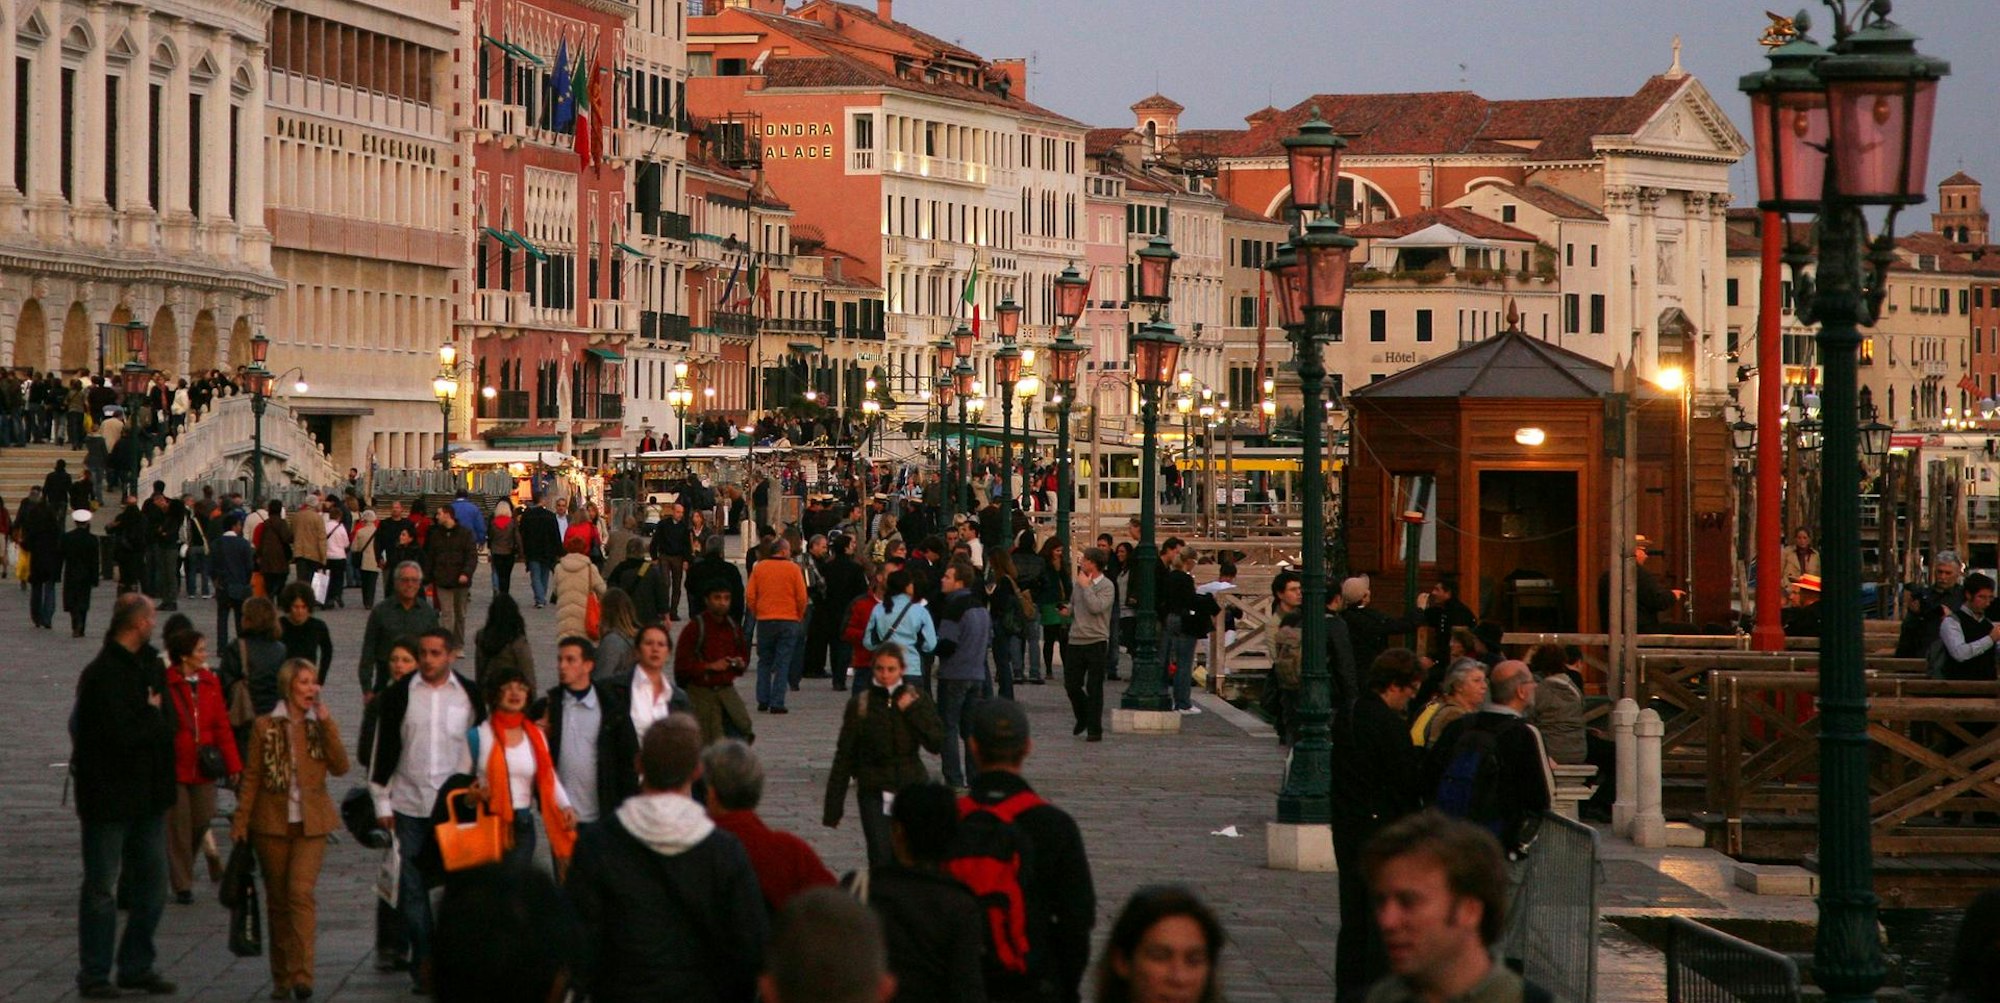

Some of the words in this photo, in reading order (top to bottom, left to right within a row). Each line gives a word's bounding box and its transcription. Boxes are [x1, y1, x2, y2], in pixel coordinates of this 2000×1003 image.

[277, 116, 343, 147] DANIELI
[362, 133, 436, 165] EXCELSIOR
[764, 146, 833, 159] ALACE
[1385, 351, 1416, 363] Hôtel
[1182, 459, 1217, 469] TAI
